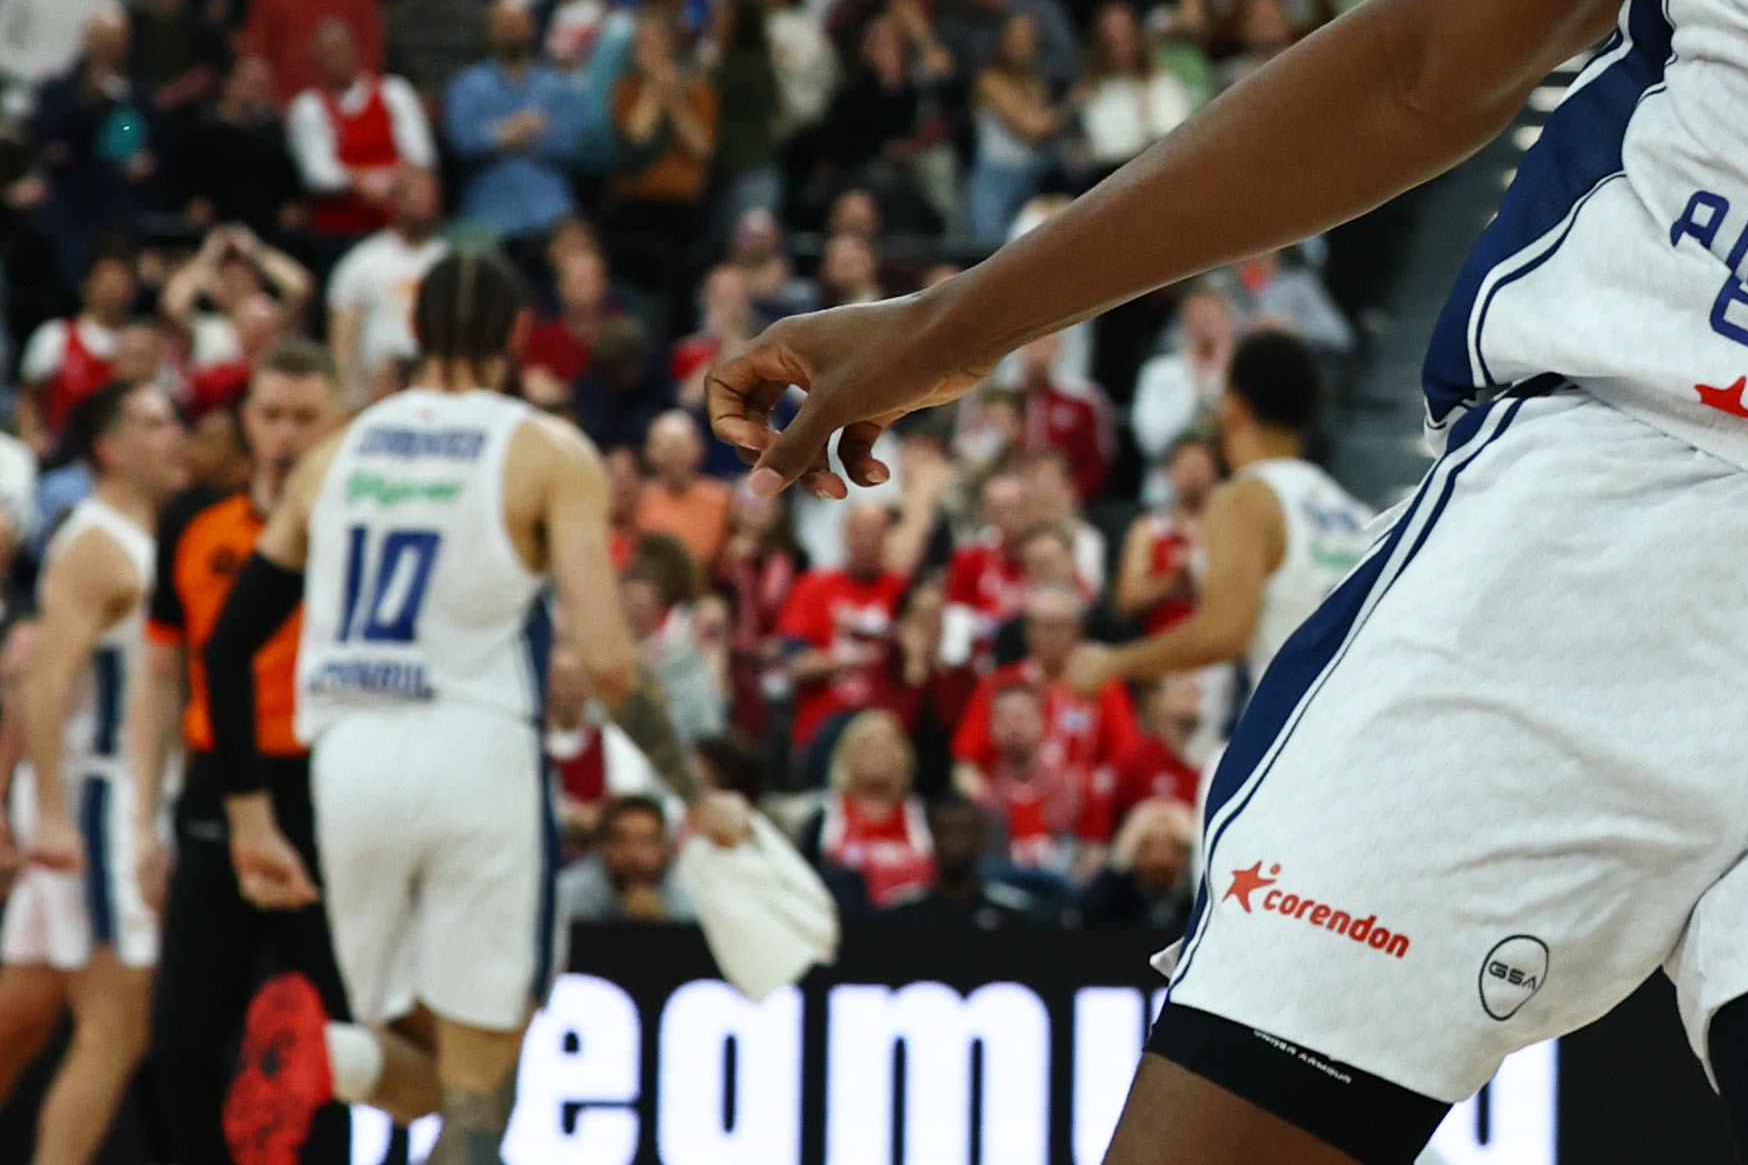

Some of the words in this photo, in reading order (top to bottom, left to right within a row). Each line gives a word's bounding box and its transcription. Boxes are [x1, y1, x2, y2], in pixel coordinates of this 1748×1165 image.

[336, 523, 442, 643] 10
[1263, 889, 1410, 958] corendon
[1488, 960, 1537, 991] GSA
